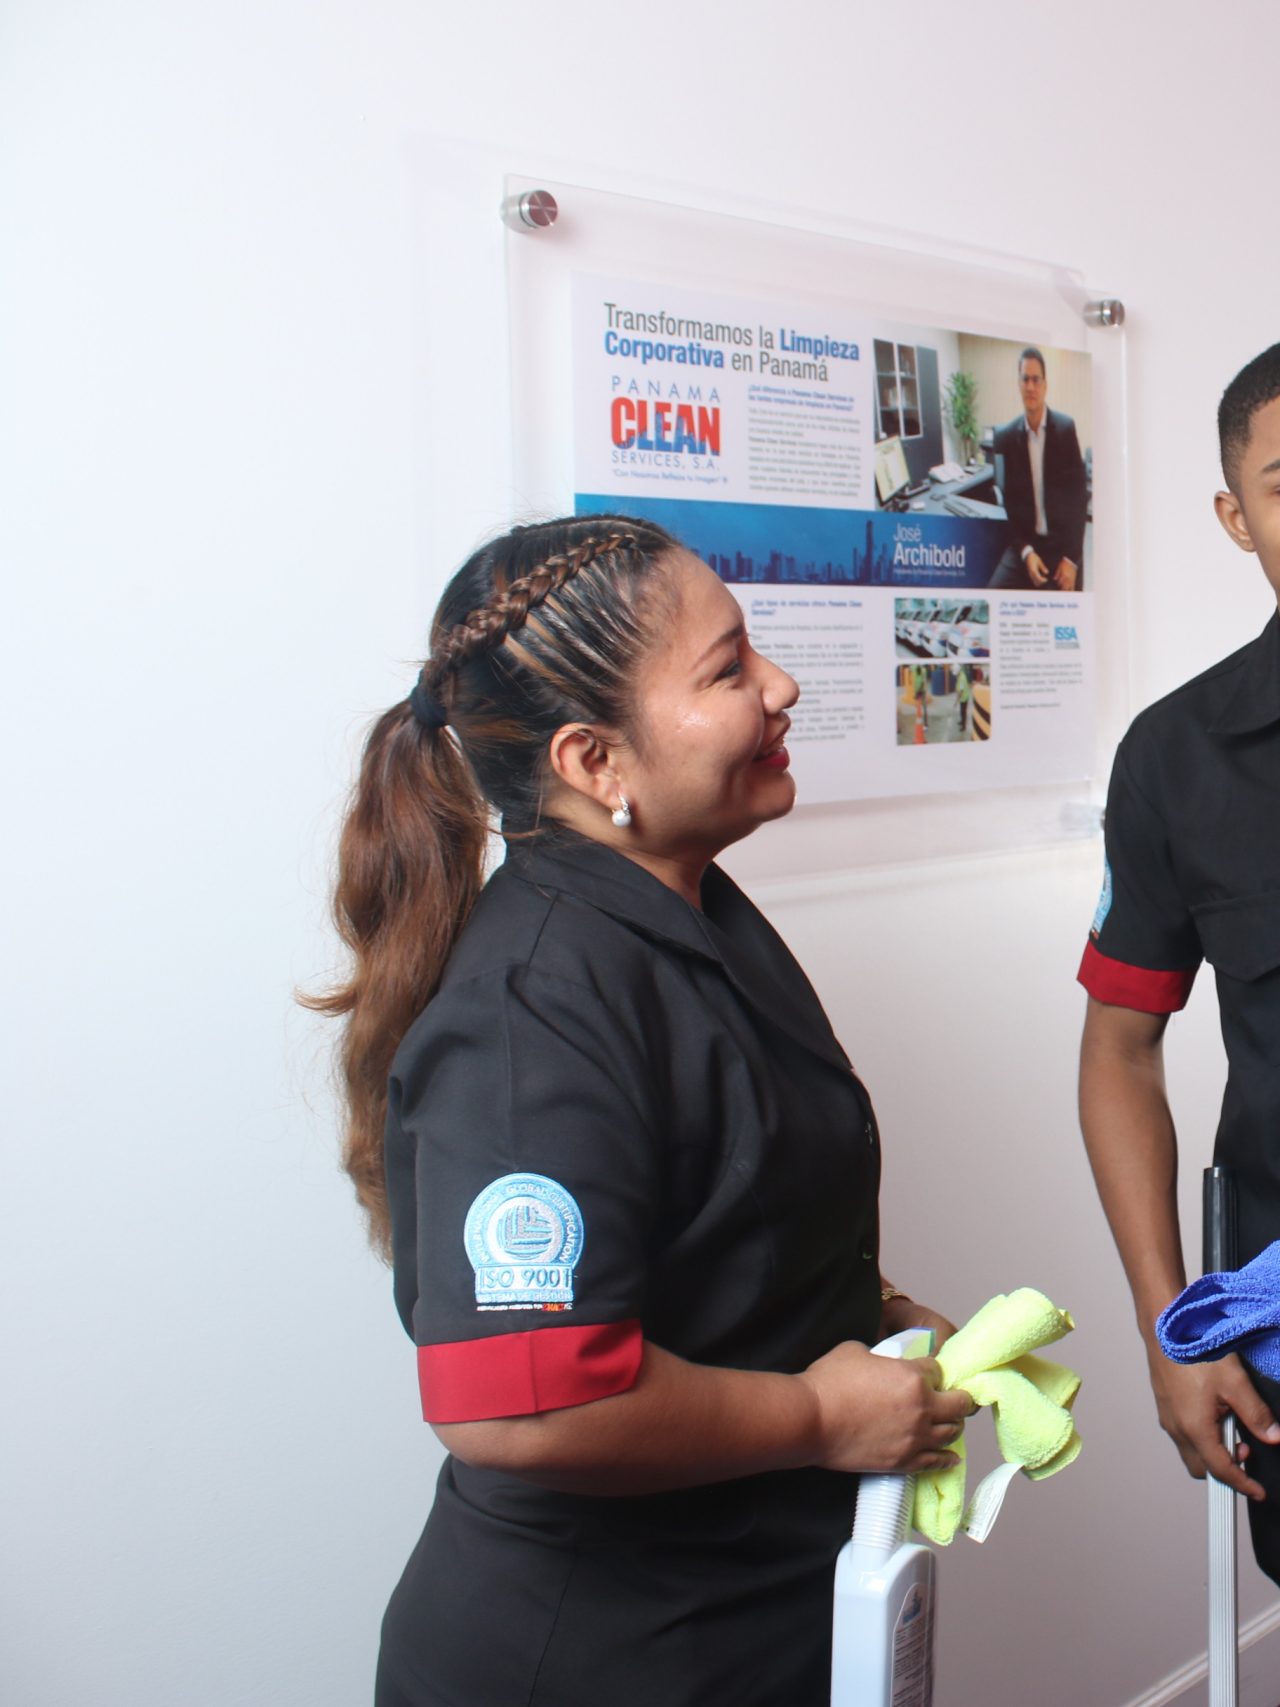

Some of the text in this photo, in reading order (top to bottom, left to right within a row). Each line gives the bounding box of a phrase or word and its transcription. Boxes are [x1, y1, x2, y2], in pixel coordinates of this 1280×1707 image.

[604, 303, 859, 361] Transformamos la Limpieza
[604, 331, 828, 382] Corporativa en Panamá
[612, 375, 720, 403] PANAMA
[611, 397, 720, 456] CLEAN
[693, 456, 720, 471] S.A.
[893, 522, 921, 542] José
[893, 542, 966, 568] Archibold
[481, 1268, 570, 1288] ISO 9001
